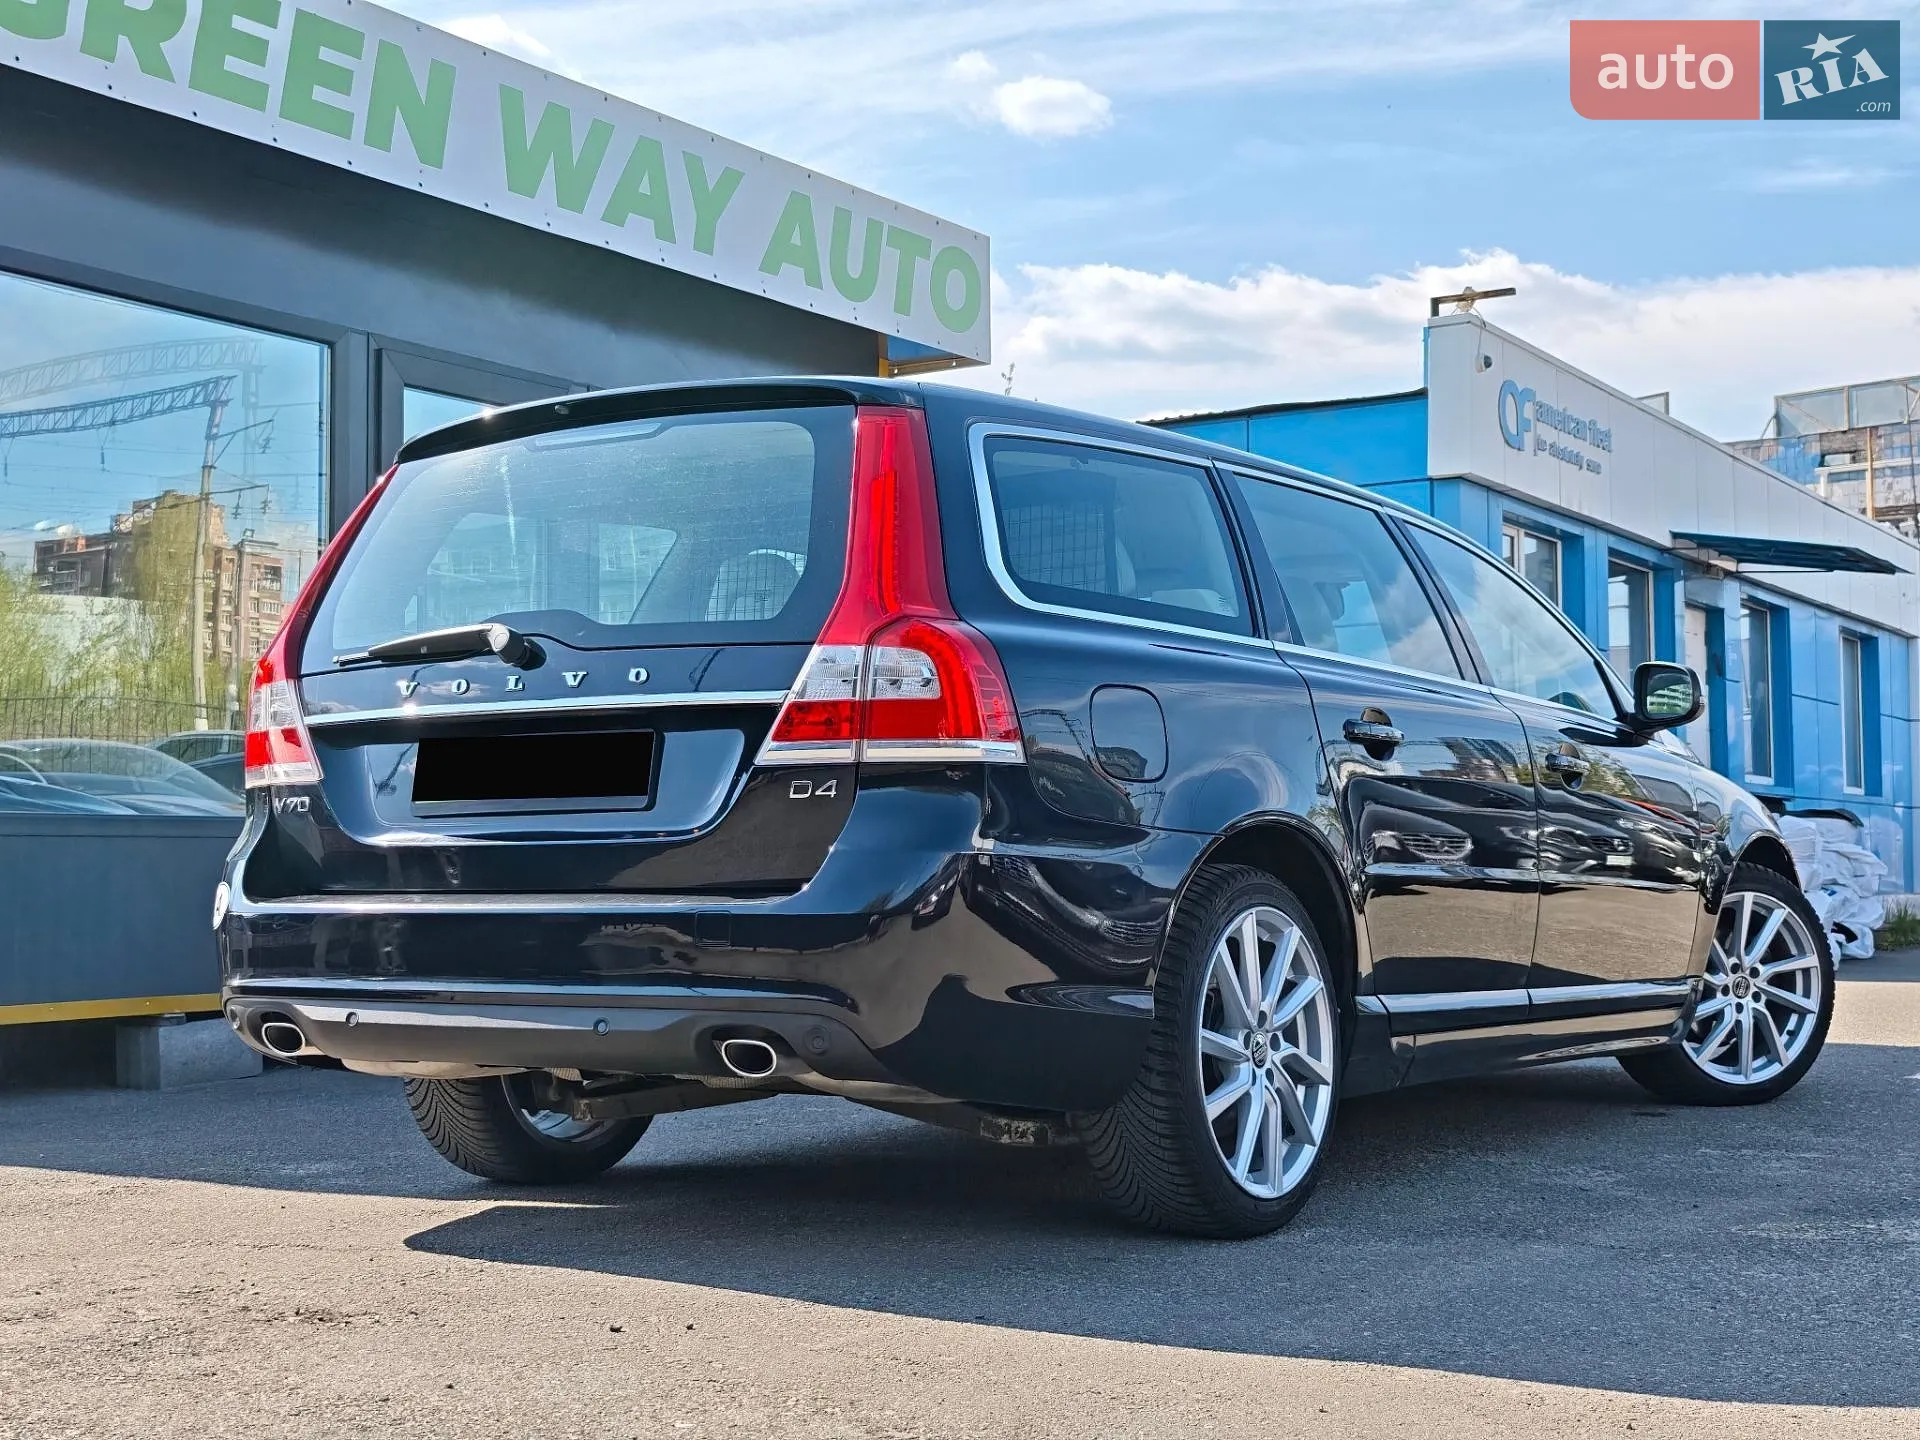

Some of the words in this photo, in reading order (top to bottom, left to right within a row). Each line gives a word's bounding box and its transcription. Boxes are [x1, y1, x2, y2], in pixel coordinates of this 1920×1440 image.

[500, 83, 746, 257] WAY
[758, 191, 982, 334] AUTO
[399, 667, 650, 698] VOLVO
[789, 780, 838, 798] D4
[275, 797, 311, 814] V70
